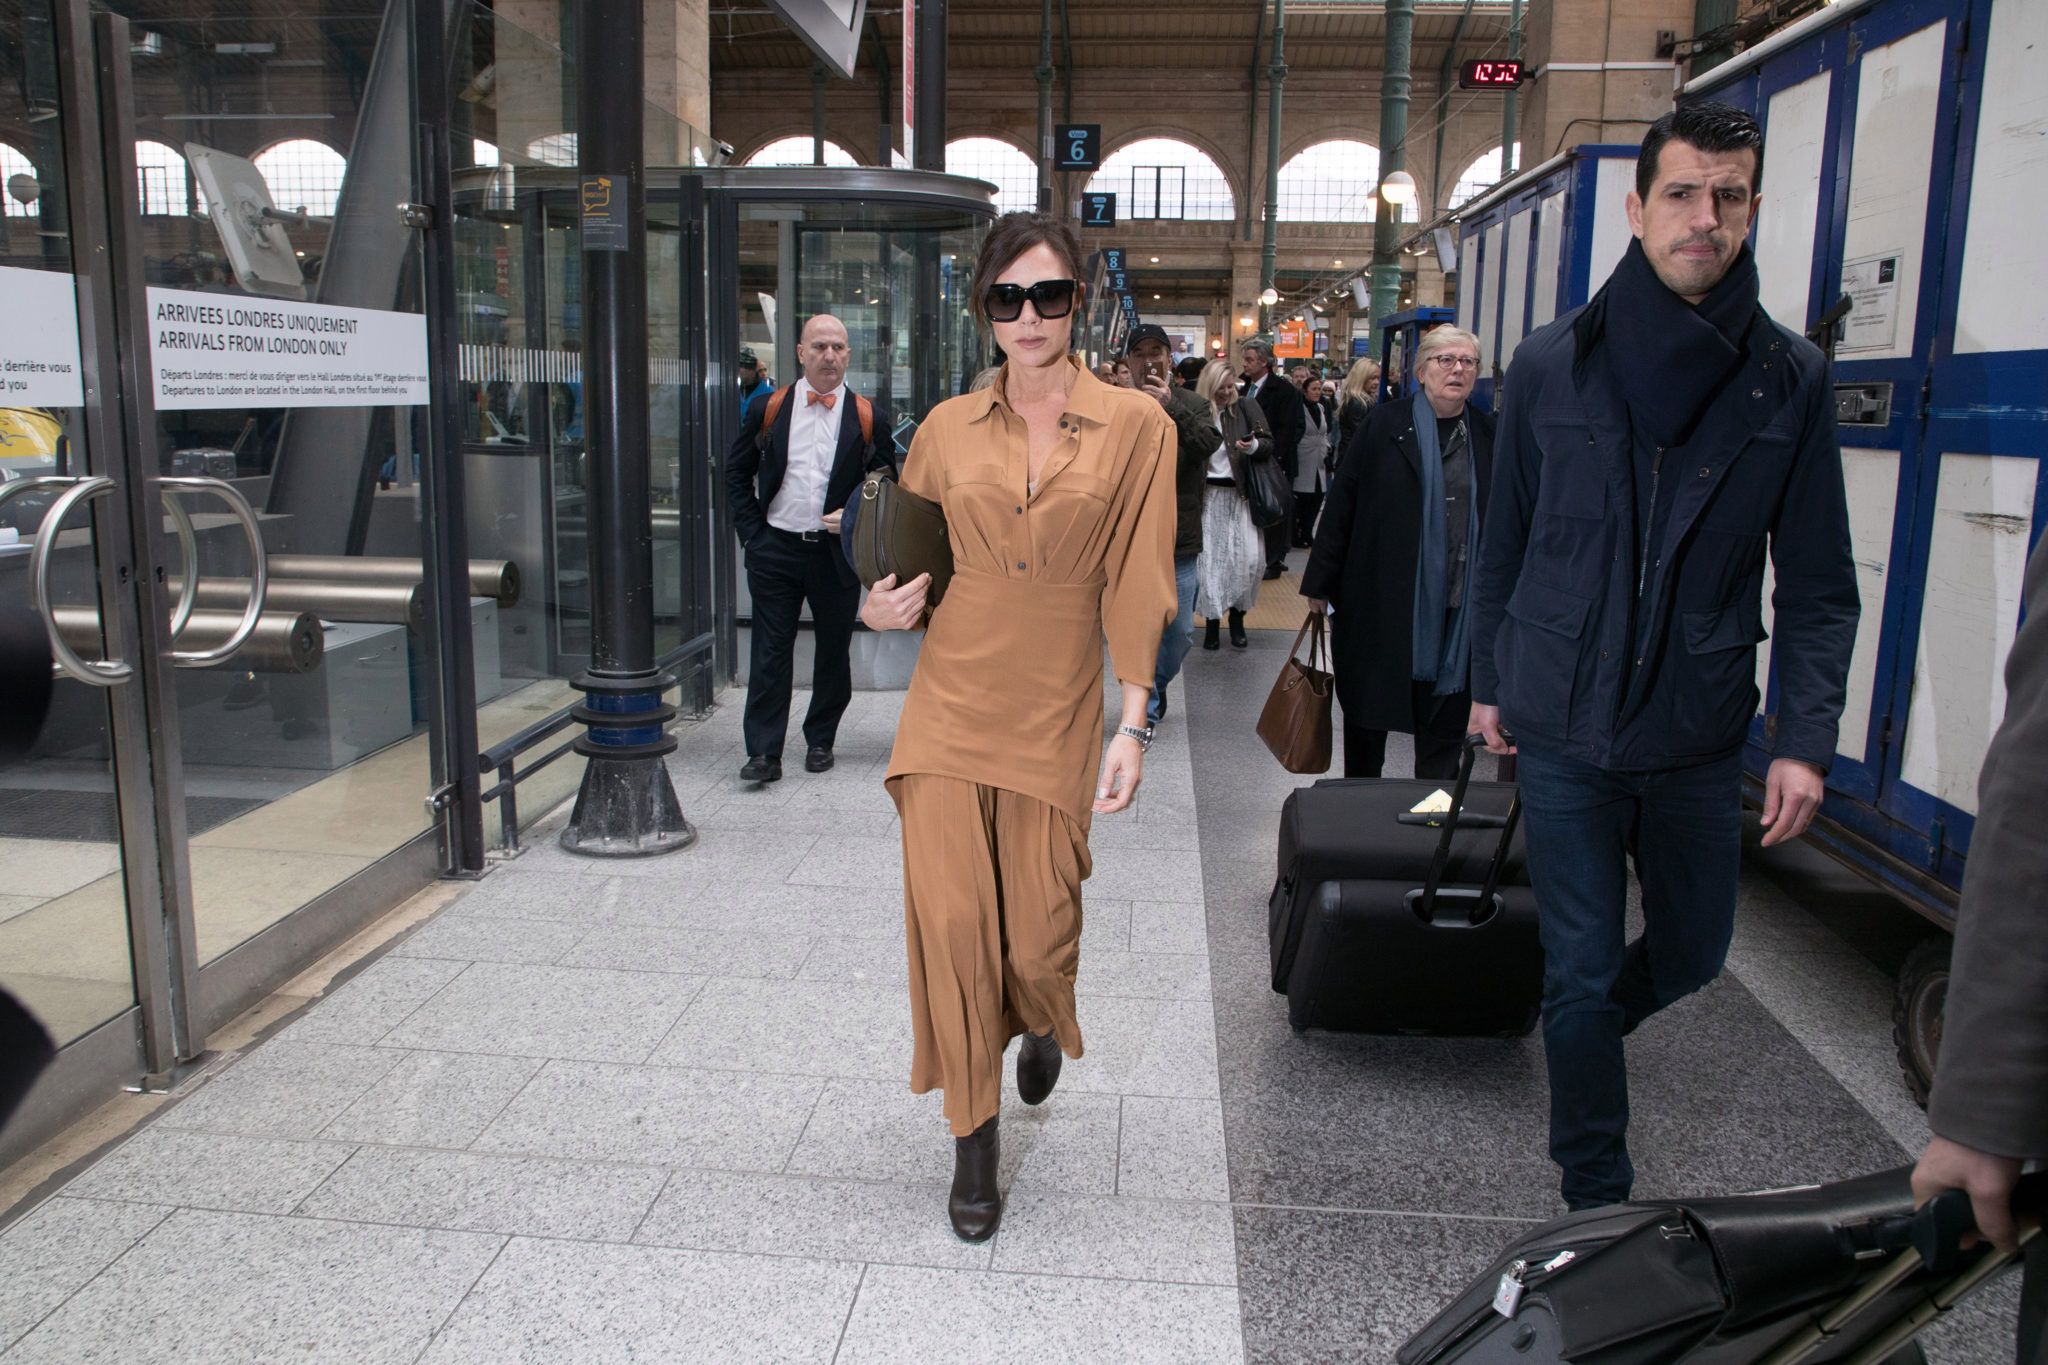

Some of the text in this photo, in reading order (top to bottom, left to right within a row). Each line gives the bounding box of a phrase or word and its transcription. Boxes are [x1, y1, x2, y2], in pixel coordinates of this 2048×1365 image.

[1070, 140, 1085, 161] 6
[1093, 204, 1105, 220] 7
[1109, 256, 1118, 268] 8
[1116, 278, 1124, 288] 9
[1122, 299, 1133, 308] 10
[157, 303, 358, 334] ARRIVEES LONDRES UNIQUEMENT
[159, 331, 347, 356] ARRIVALS FROM LONDON ONLY
[5, 360, 46, 373] derrière
[48, 364, 72, 373] vous
[160, 368, 192, 383] Départs
[193, 369, 223, 380] Londres
[228, 370, 248, 380] merci
[249, 371, 258, 380] de
[259, 372, 275, 381] vous
[276, 371, 296, 383] diriger
[297, 373, 310, 382] vers
[310, 373, 316, 381] le
[317, 372, 329, 381] Hall
[330, 373, 352, 382] Londres
[8, 380, 28, 393] you
[162, 384, 205, 398] Departures
[207, 386, 215, 395] to
[216, 385, 243, 395] London
[244, 387, 255, 395] are
[257, 386, 281, 395] located
[289, 385, 300, 395] the
[301, 385, 323, 394] London
[346, 386, 355, 394] the
[381, 385, 398, 394] behind
